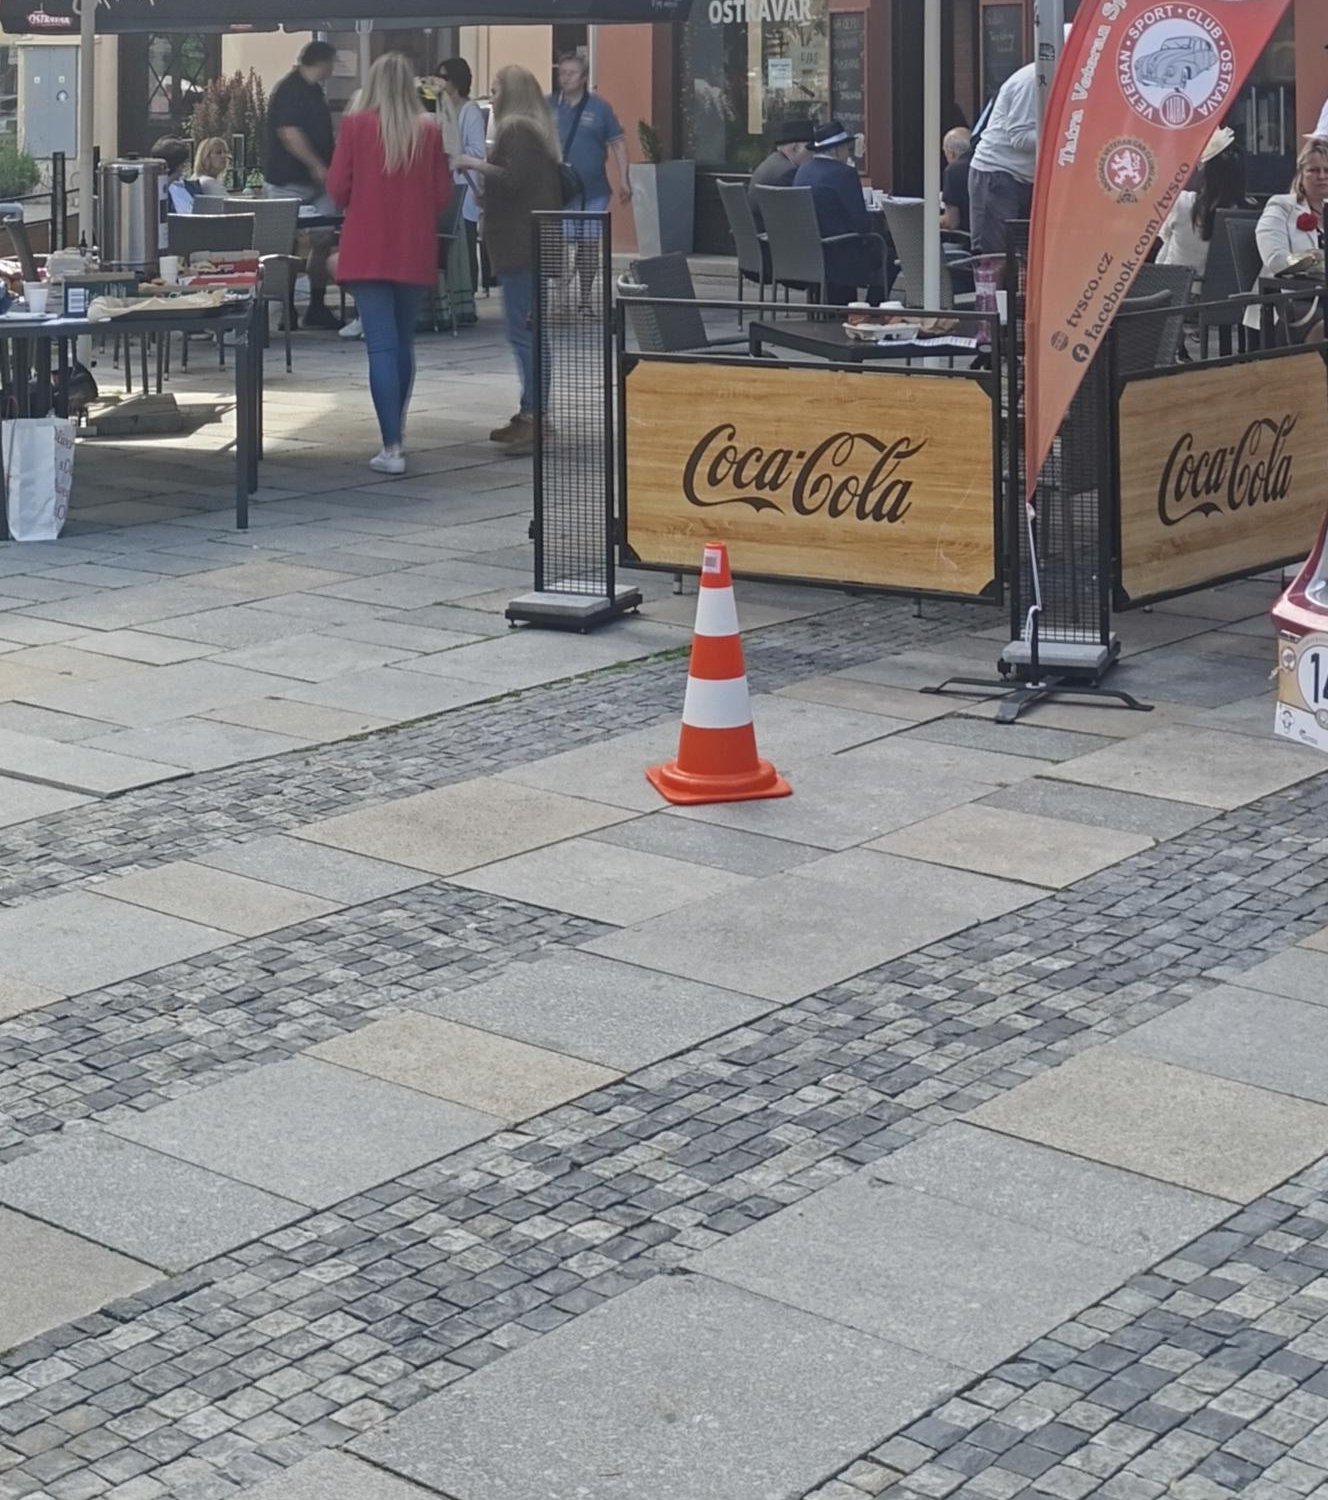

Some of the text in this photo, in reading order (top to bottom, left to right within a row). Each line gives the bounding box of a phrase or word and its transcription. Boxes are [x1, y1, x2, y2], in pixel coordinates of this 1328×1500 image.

[1128, 4, 1174, 40] SPORT
[1186, 7, 1222, 39] CLUB
[1072, 24, 1112, 102] Veteran
[1118, 50, 1154, 120] VETERAN
[1197, 50, 1232, 117] OSTRAVA
[1066, 251, 1115, 329] tvsco.cz
[1084, 161, 1190, 343] facebook.com/tvsco
[683, 423, 928, 524] Coca-Cola
[1158, 414, 1298, 525] Coca-Cola
